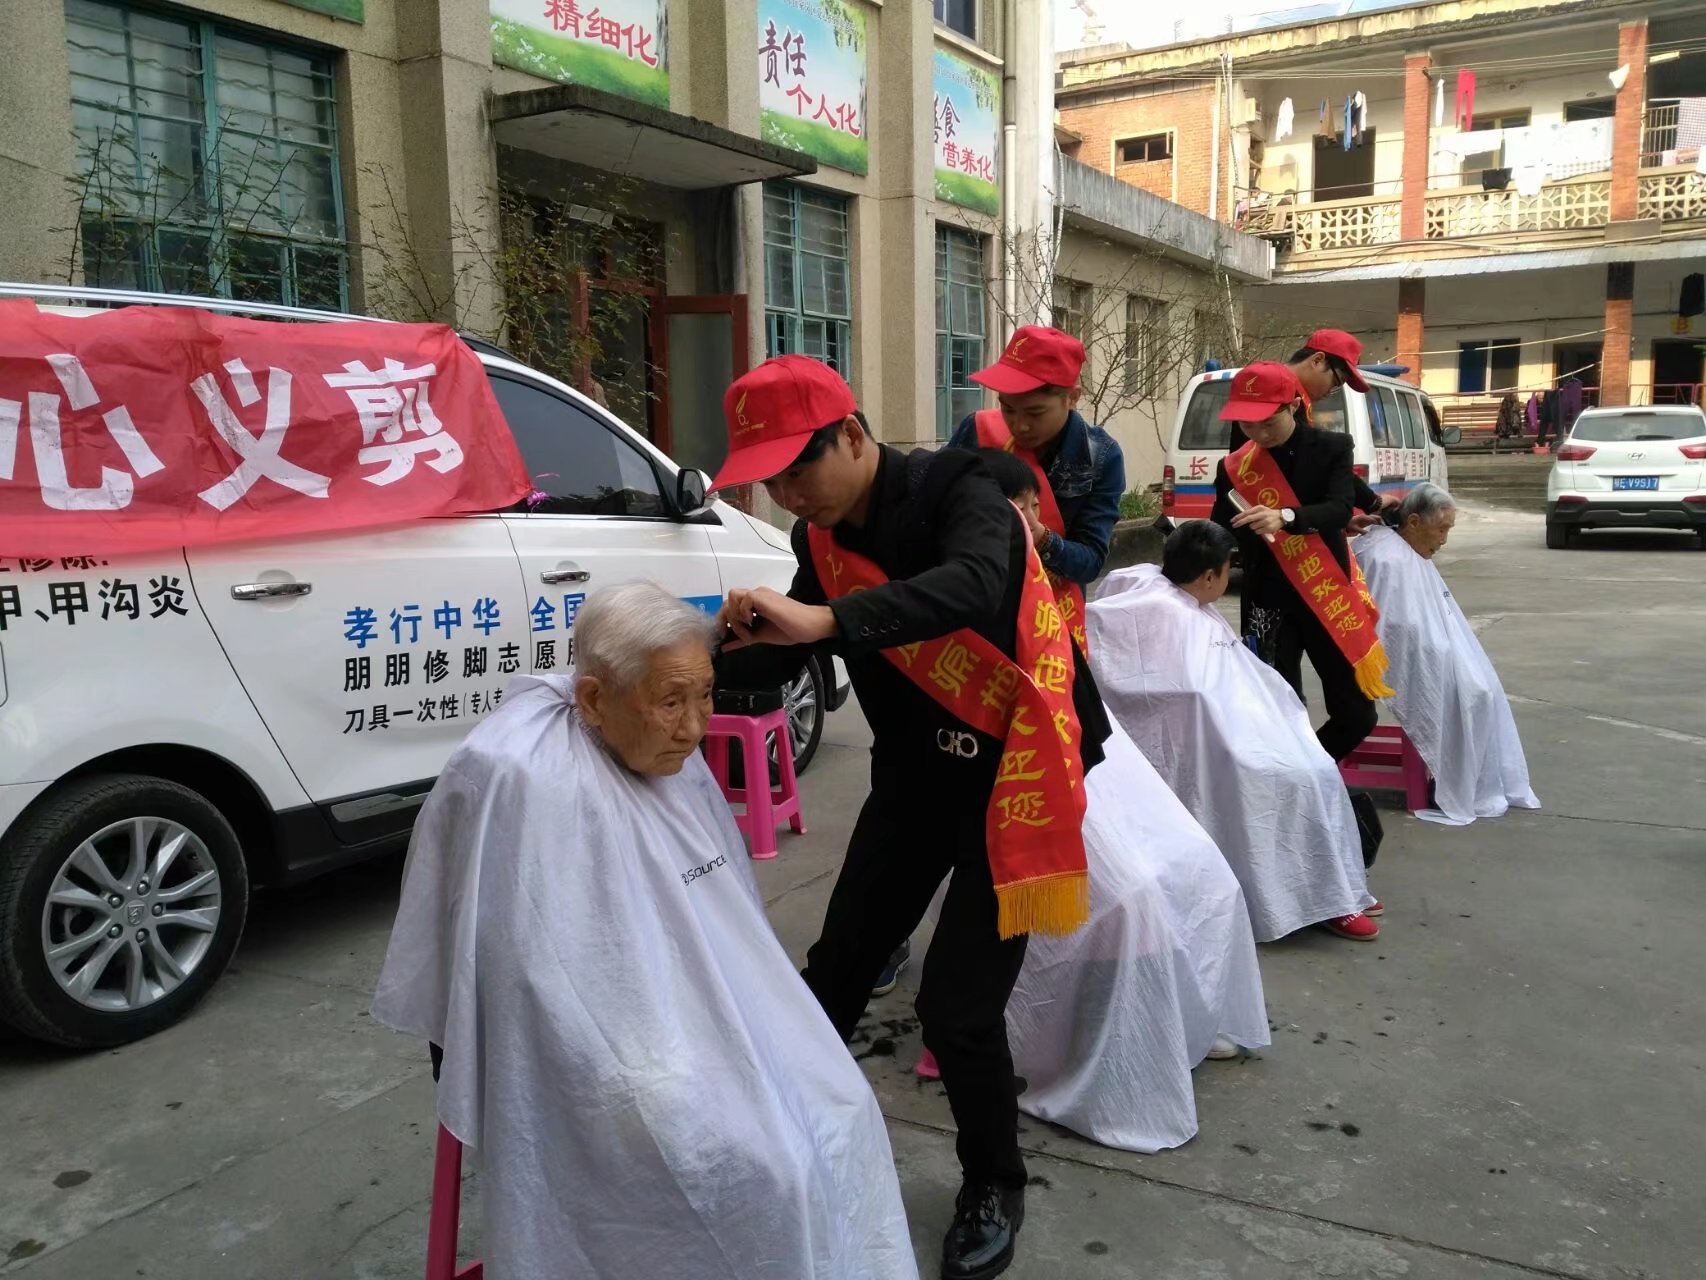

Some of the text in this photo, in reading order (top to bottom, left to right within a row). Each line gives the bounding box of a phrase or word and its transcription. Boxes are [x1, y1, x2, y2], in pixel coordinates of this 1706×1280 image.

[544, 0, 657, 66] 精细化
[759, 20, 807, 88] 责任
[786, 83, 860, 136] 个人化
[943, 141, 994, 181] 营养化
[0, 353, 464, 511] 心义剪
[1190, 456, 1209, 475] 长
[344, 597, 501, 649] 孝行中华
